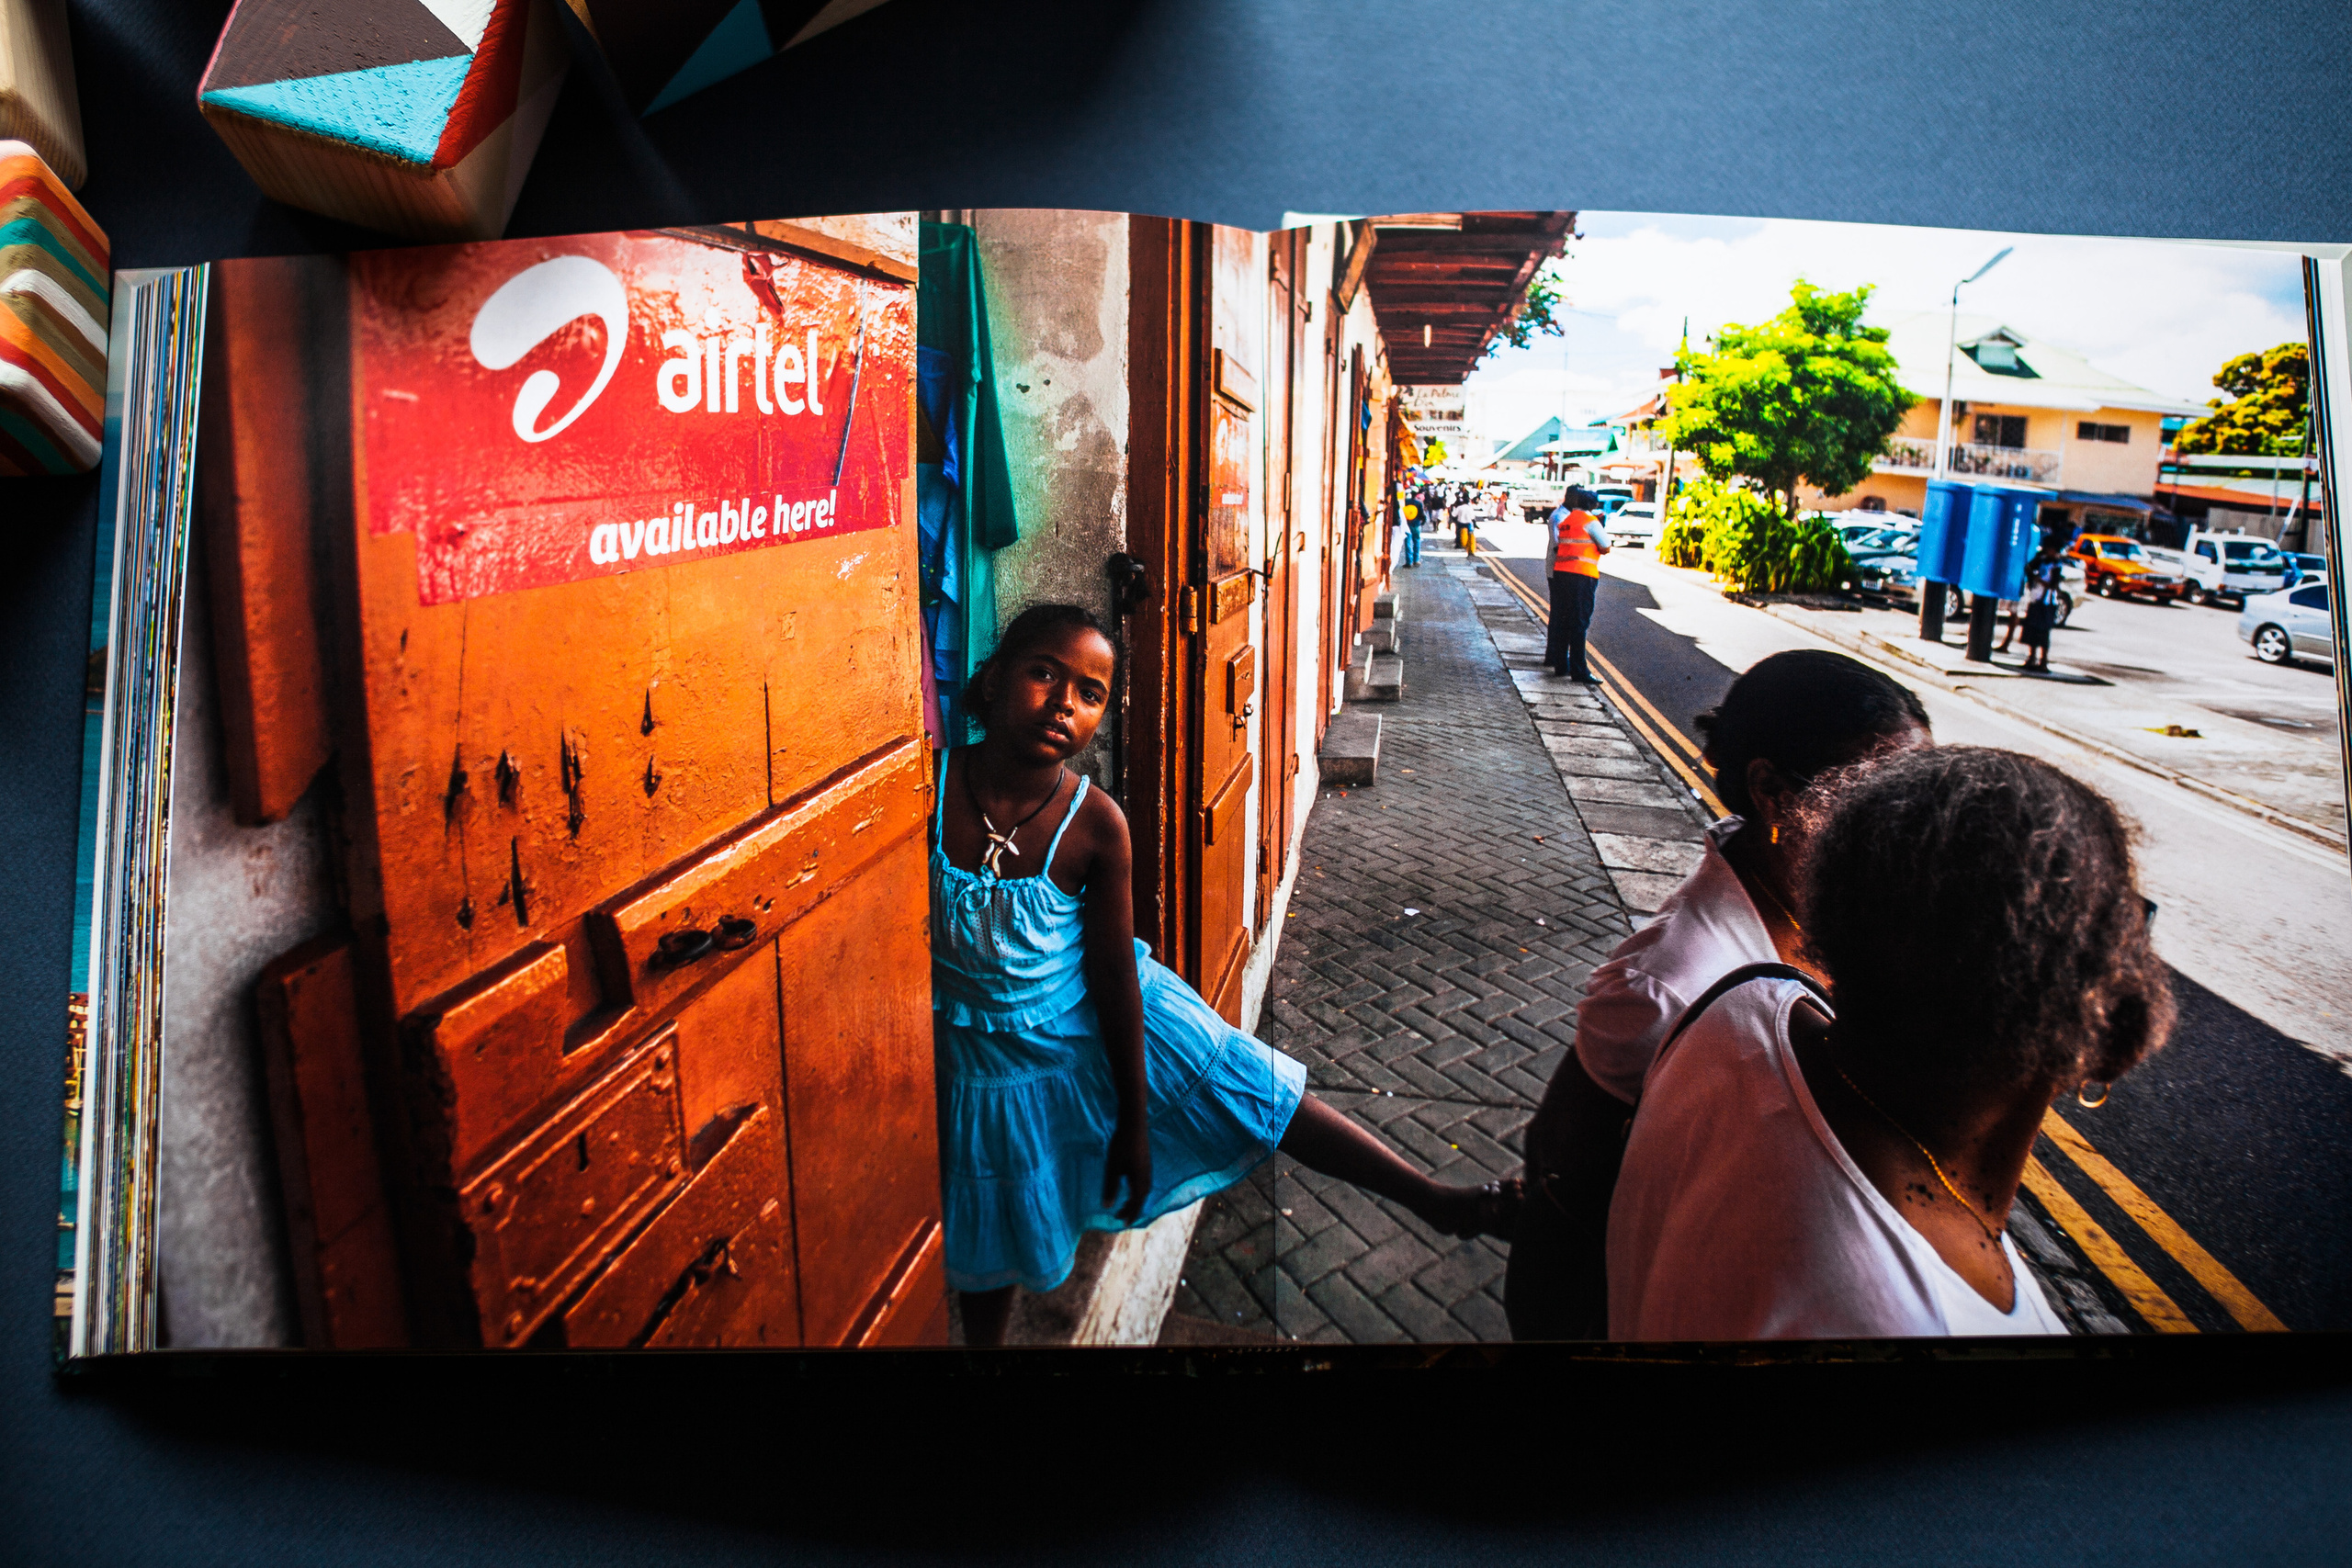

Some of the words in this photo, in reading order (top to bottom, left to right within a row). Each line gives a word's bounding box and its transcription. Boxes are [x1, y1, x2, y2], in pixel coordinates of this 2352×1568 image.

[657, 307, 823, 416] airtel
[589, 498, 768, 565] available
[773, 489, 837, 536] here!
